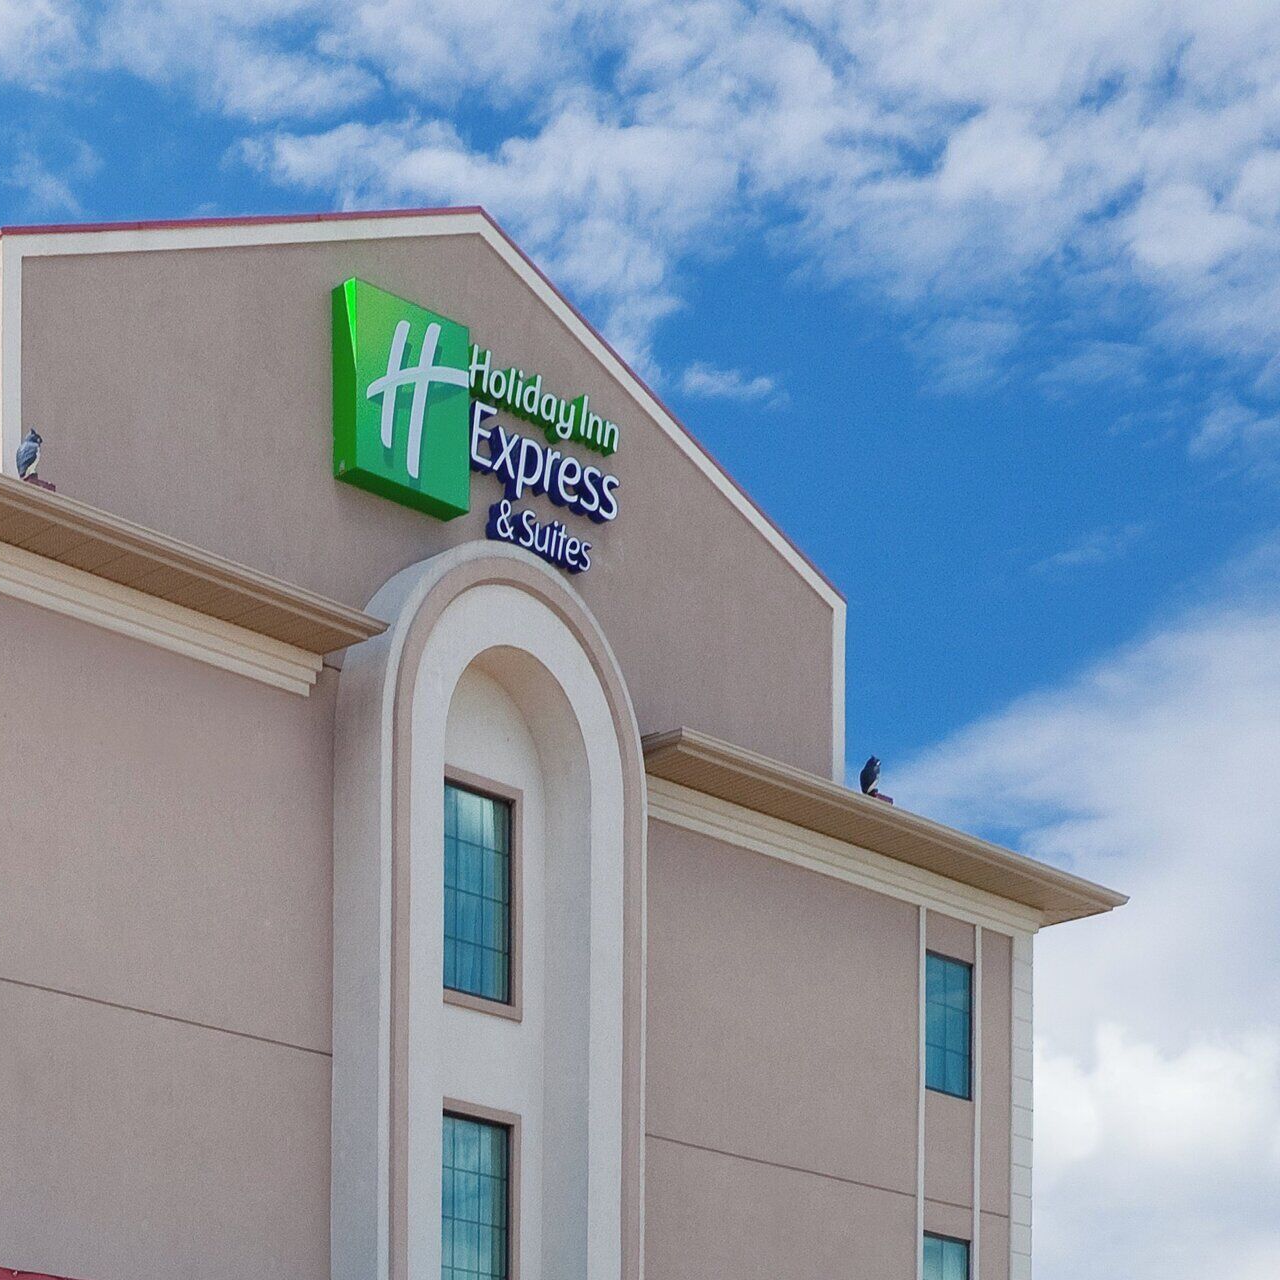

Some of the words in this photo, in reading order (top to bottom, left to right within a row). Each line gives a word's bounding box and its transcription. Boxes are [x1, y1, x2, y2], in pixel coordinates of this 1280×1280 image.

[469, 344, 576, 440] Holiday
[579, 394, 620, 453] Inn
[470, 400, 621, 521] Express
[496, 499, 514, 540] &
[519, 509, 593, 573] Suites
